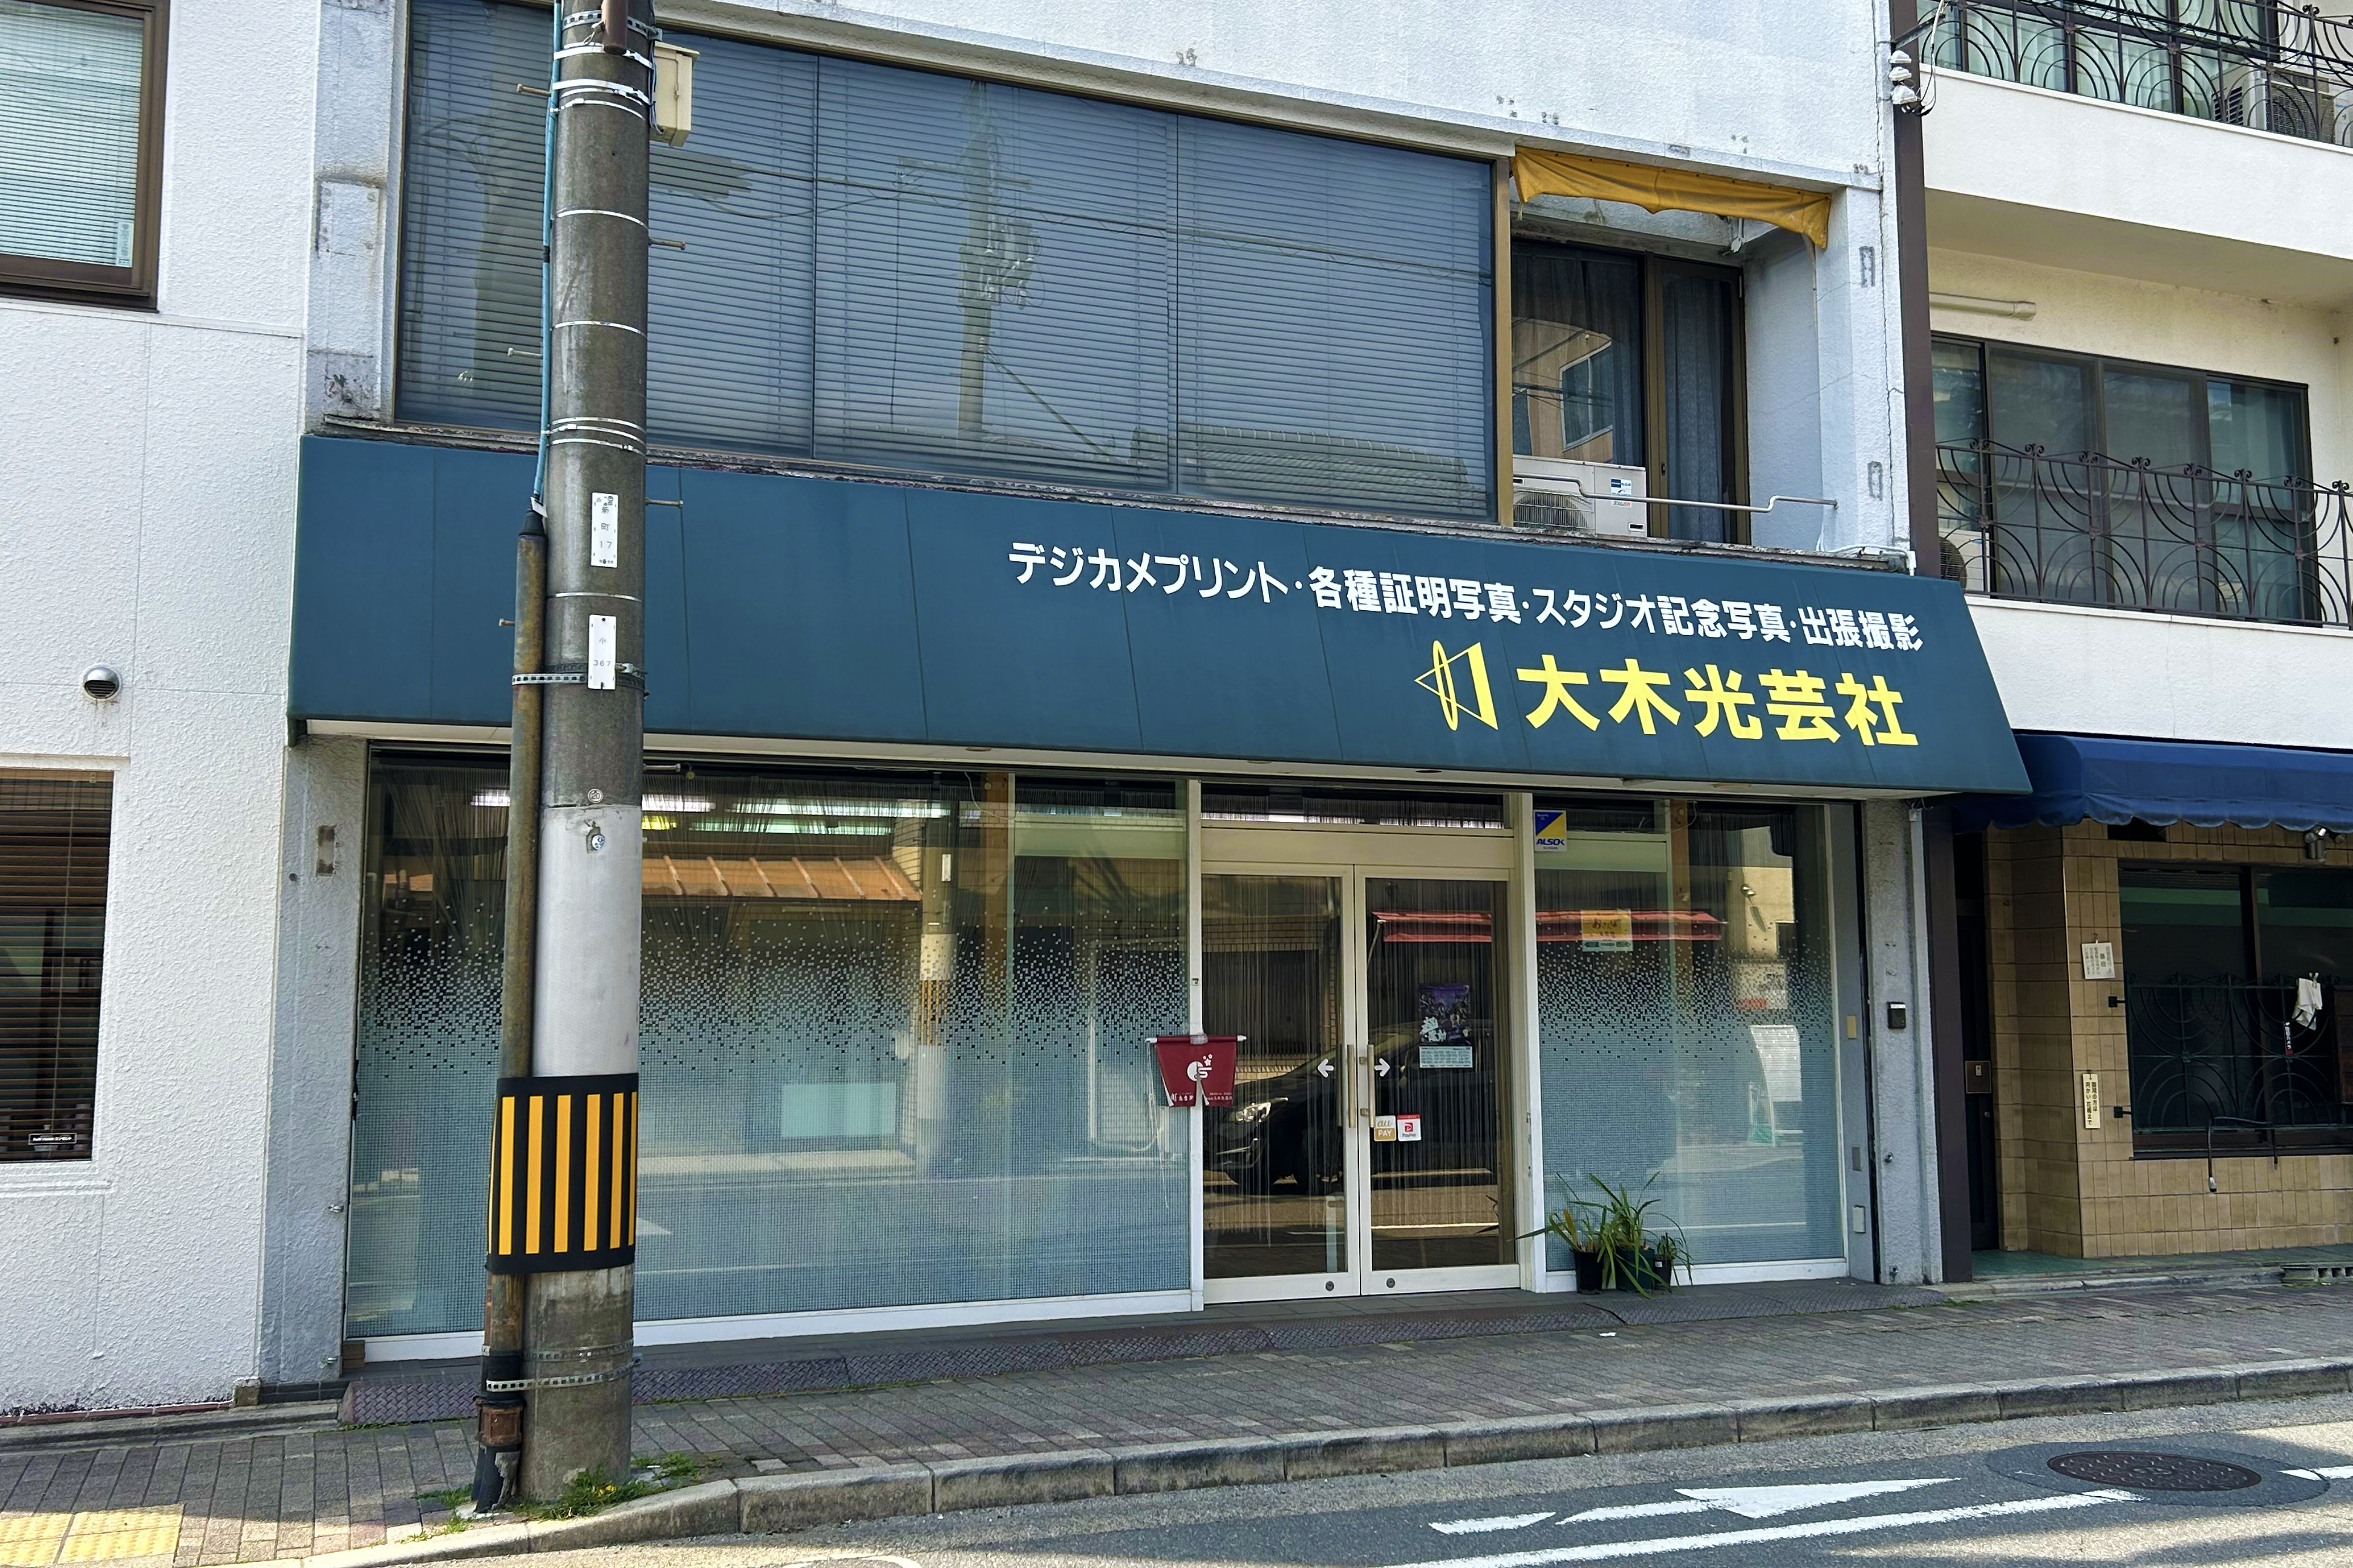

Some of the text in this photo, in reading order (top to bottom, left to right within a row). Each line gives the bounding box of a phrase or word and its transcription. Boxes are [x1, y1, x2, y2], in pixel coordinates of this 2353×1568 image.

[1516, 654, 1918, 746] 大木光芸社
